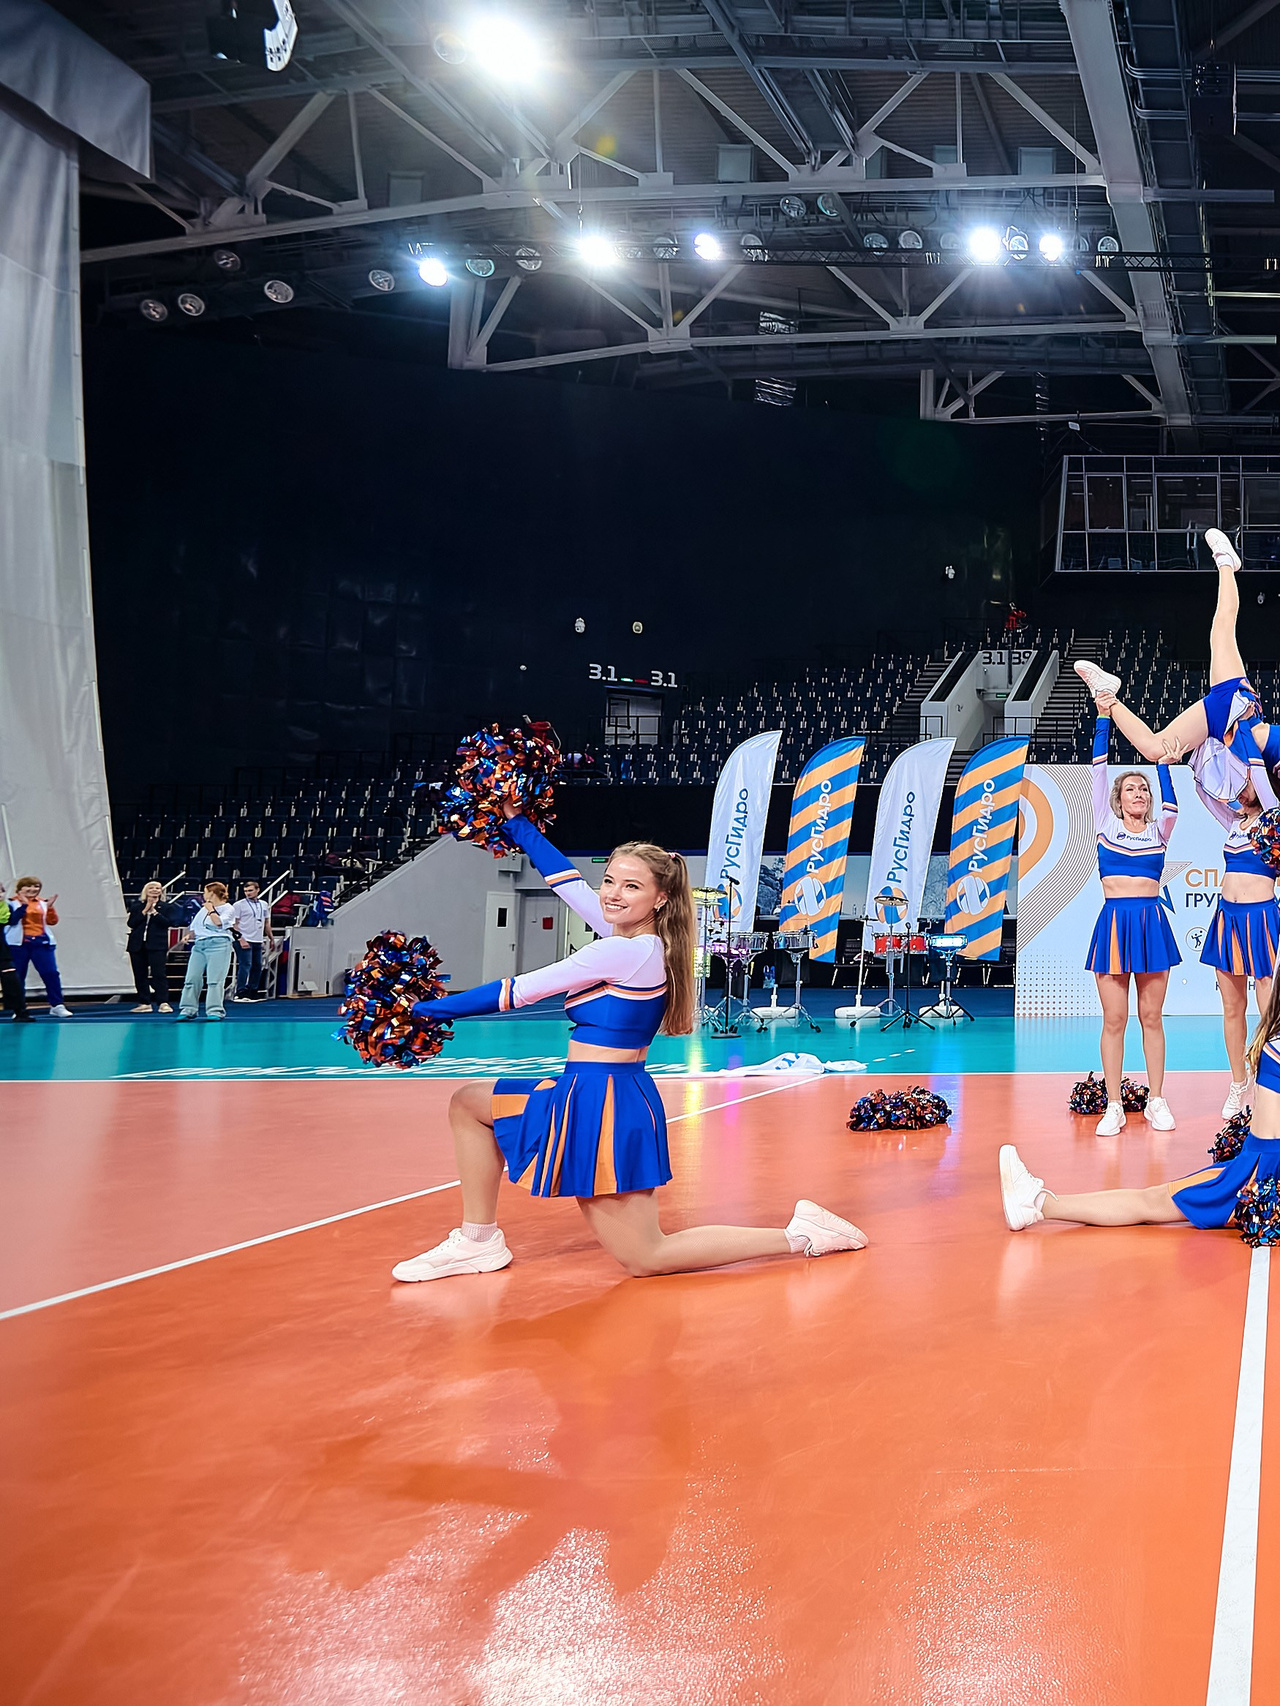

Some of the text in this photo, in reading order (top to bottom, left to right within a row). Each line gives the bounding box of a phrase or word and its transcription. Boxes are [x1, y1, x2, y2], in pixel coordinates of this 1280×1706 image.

[588, 663, 678, 688] 3.1 3.1
[982, 651, 1005, 665] 3.1
[720, 788, 749, 880] РусГидро
[807, 779, 832, 875] РусГидро
[886, 791, 916, 884] РусГидро
[968, 779, 996, 873] РусГидро
